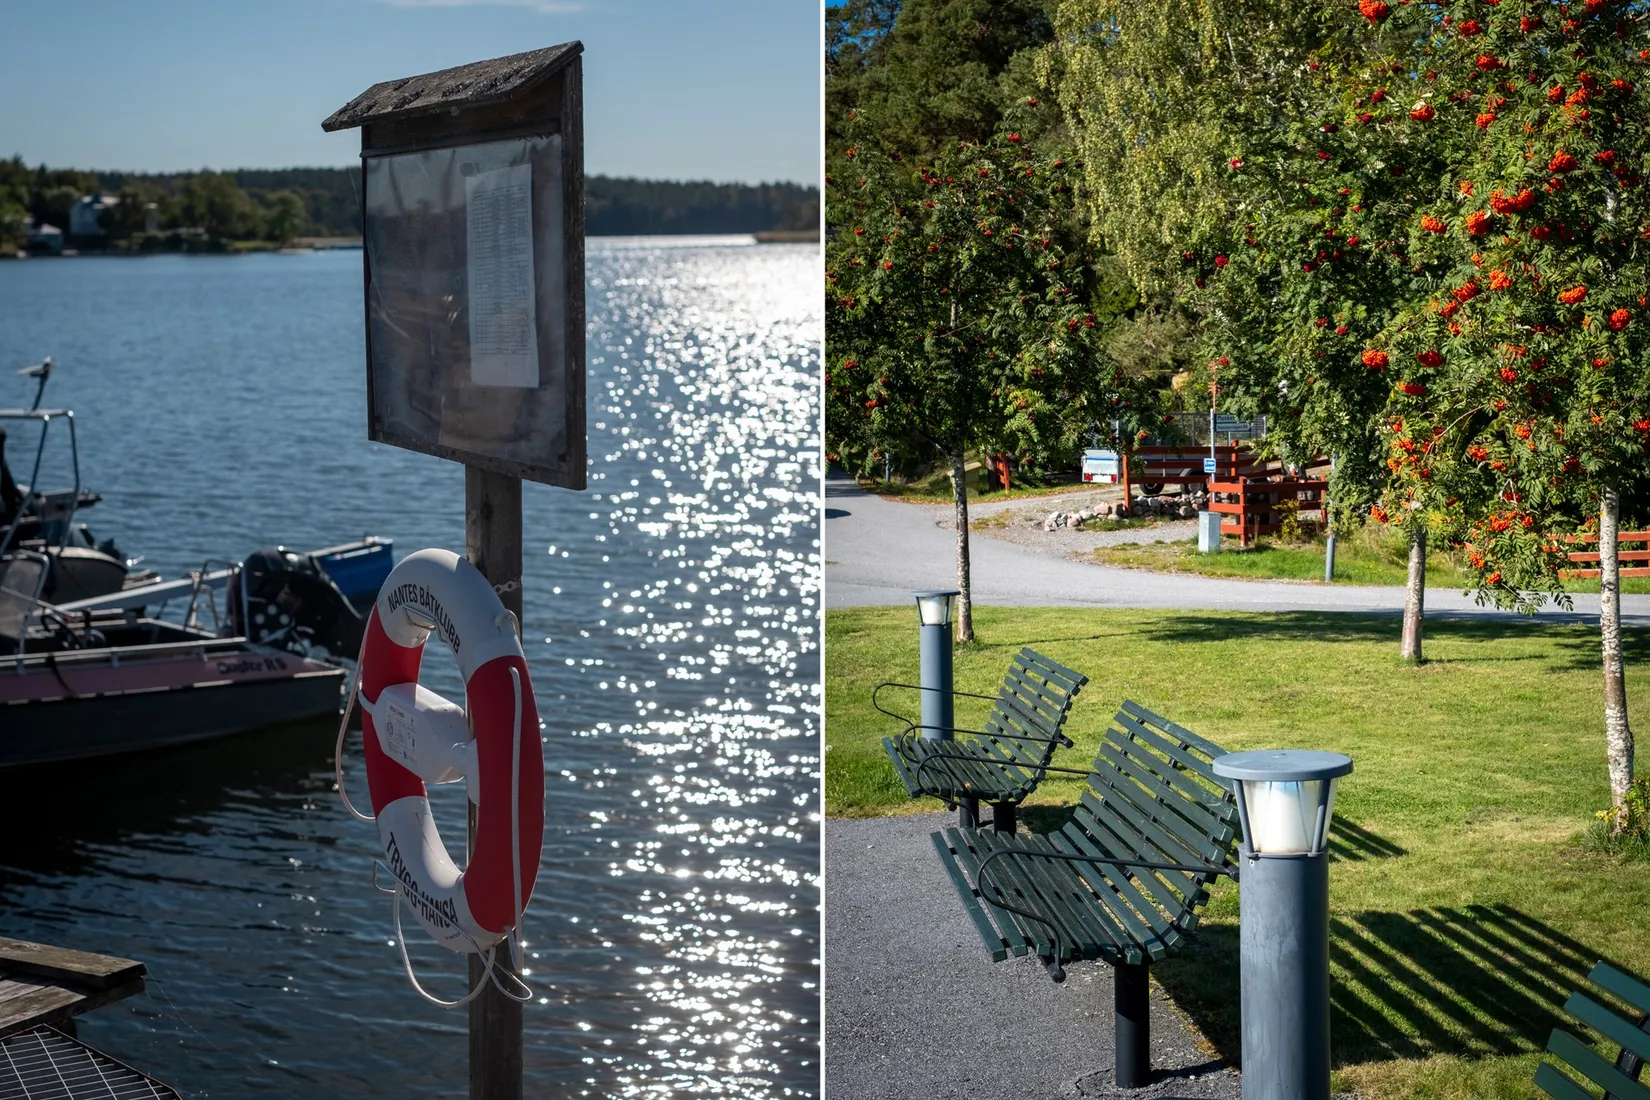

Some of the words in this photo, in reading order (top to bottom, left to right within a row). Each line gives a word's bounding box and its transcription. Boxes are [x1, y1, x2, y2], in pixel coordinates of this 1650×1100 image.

[387, 583, 418, 613] NANTES
[419, 585, 461, 654] BÅTKLUBB
[386, 832, 459, 928] TRYGG-HANSA
